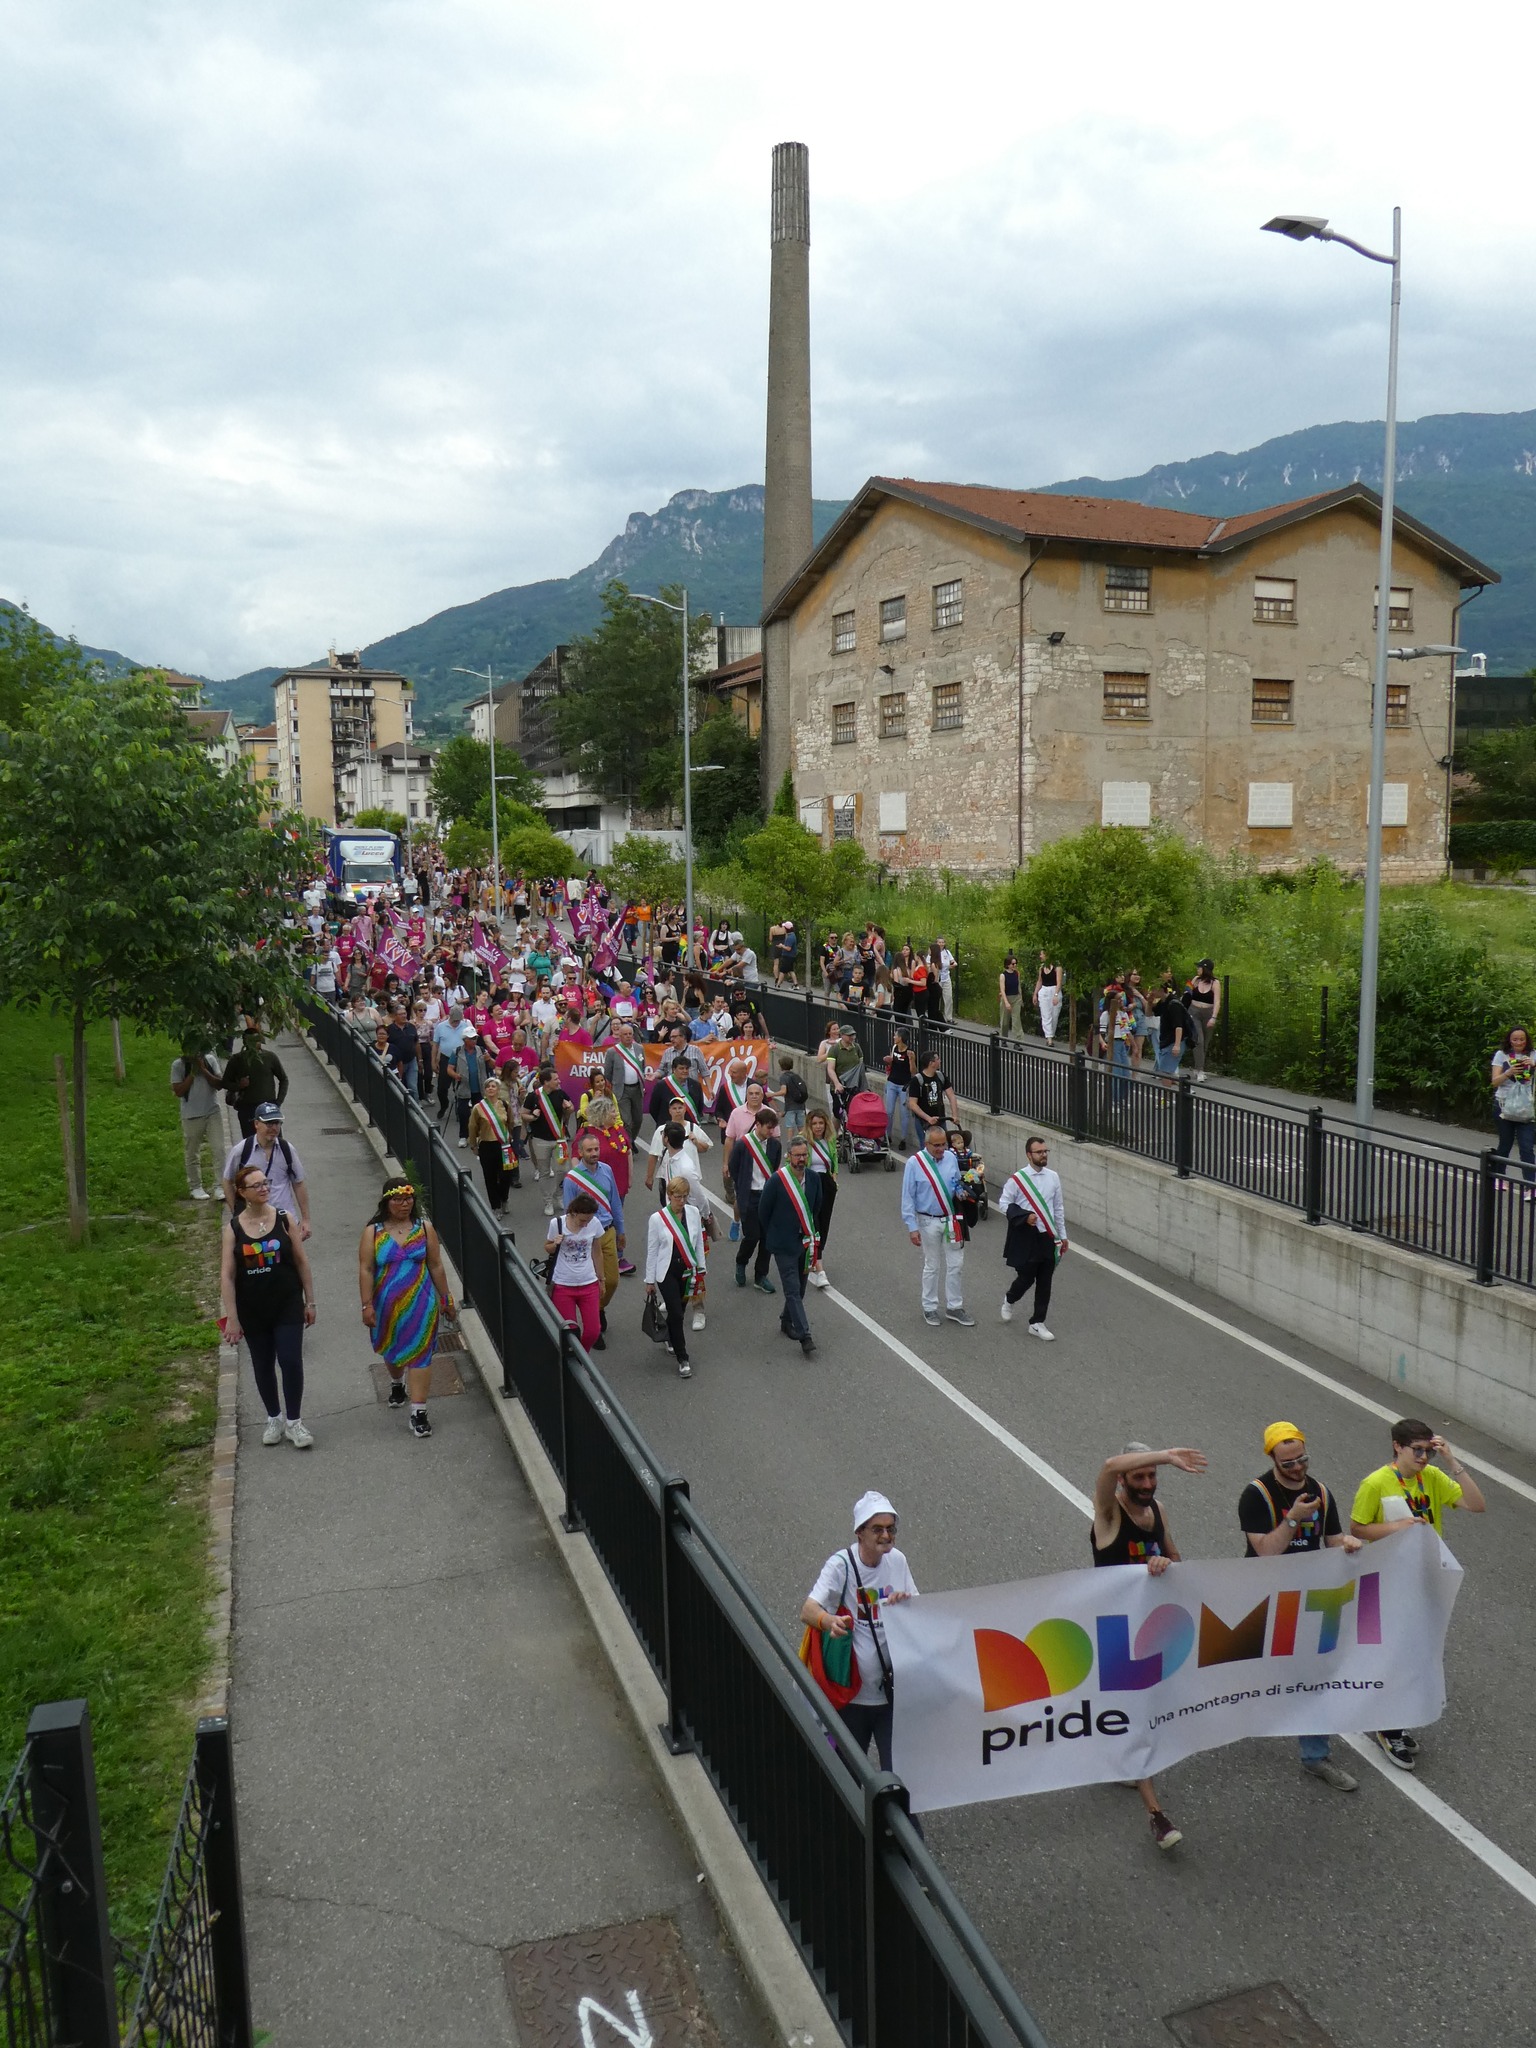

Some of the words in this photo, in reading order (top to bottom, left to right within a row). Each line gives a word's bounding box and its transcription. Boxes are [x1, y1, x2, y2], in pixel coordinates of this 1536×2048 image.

[247, 1267, 271, 1275] pride
[973, 1571, 1381, 1712] DOLOMITI
[982, 1699, 1130, 1766] pride
[1148, 1712, 1175, 1730] Una
[1178, 1687, 1262, 1717] montagna
[1265, 1679, 1282, 1696] di
[1284, 1677, 1385, 1696] sfumature
